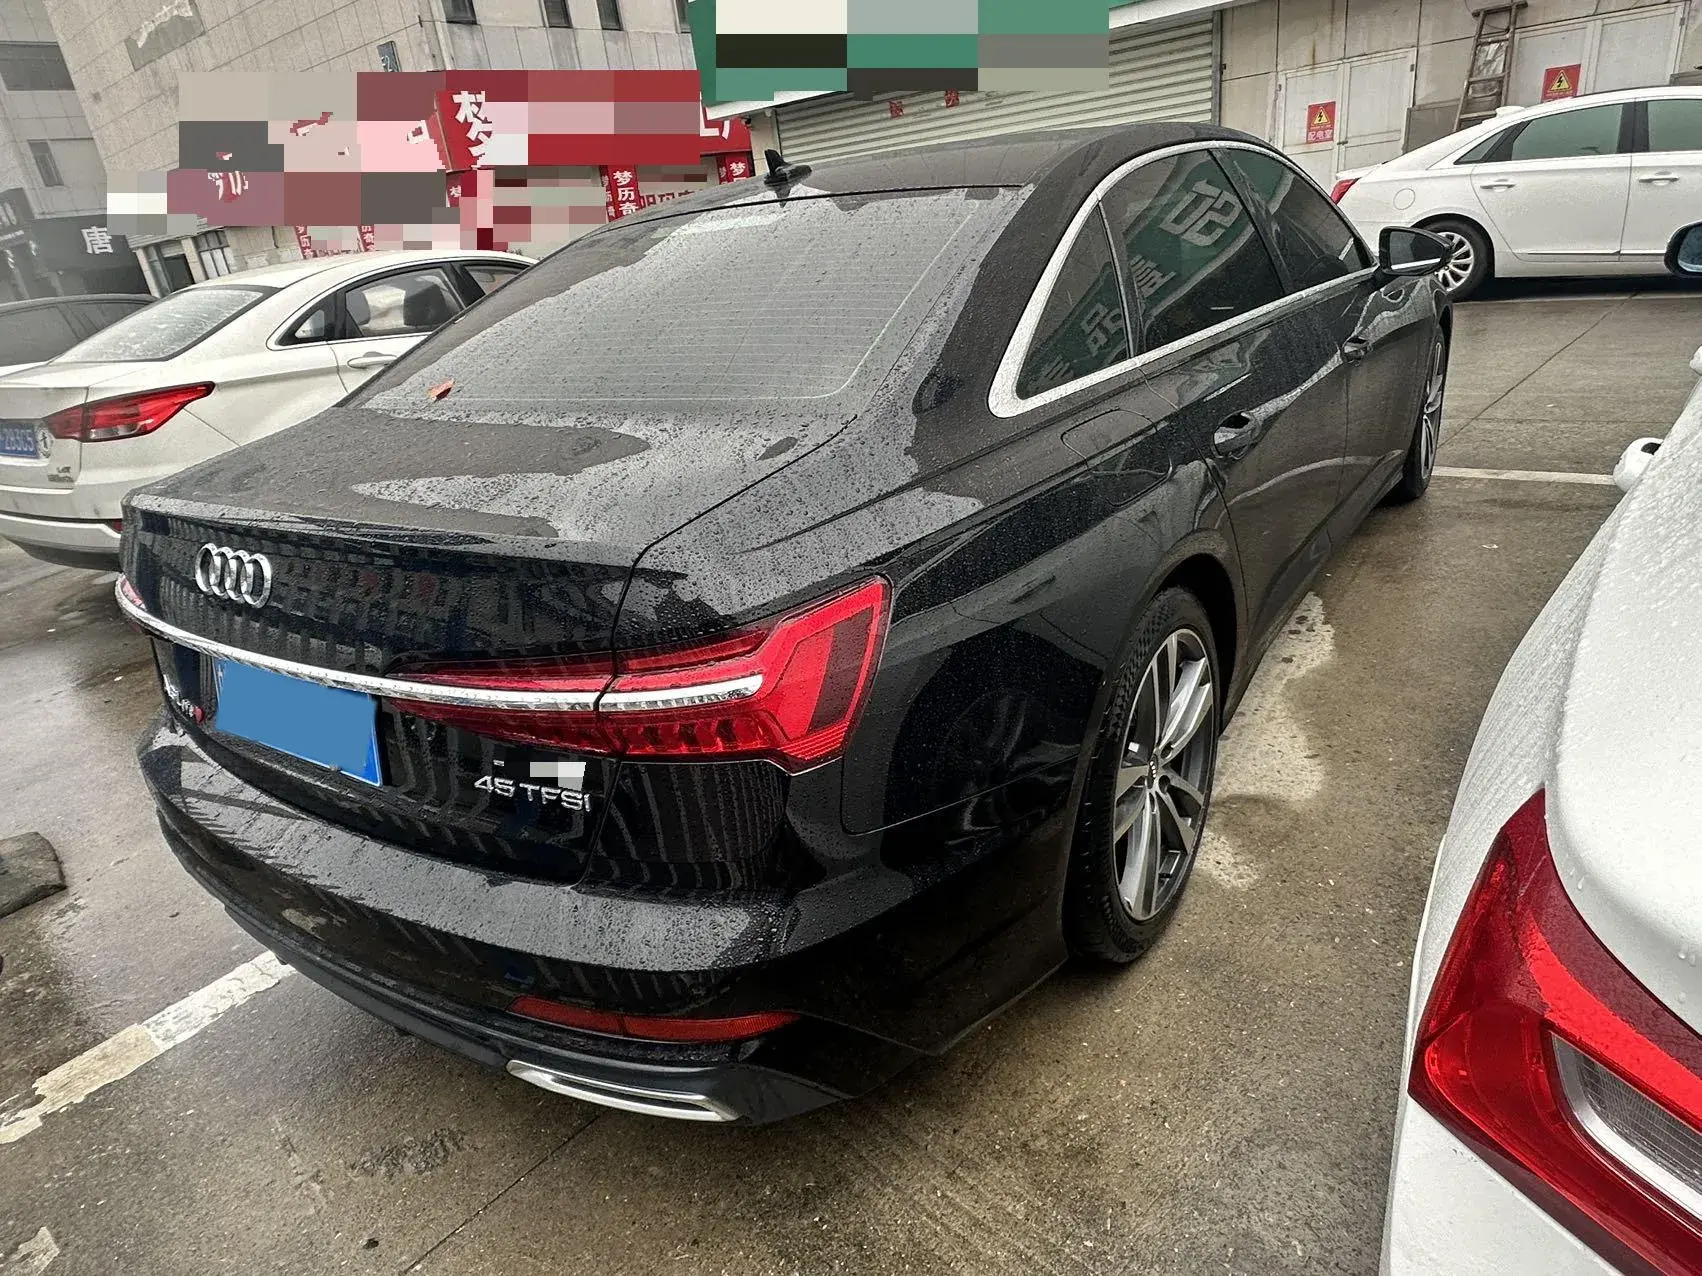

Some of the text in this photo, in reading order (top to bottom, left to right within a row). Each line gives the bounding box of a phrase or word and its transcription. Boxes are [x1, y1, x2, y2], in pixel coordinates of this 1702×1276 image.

[81, 226, 113, 254] 唐
[474, 776, 590, 812] 45 TFSI
